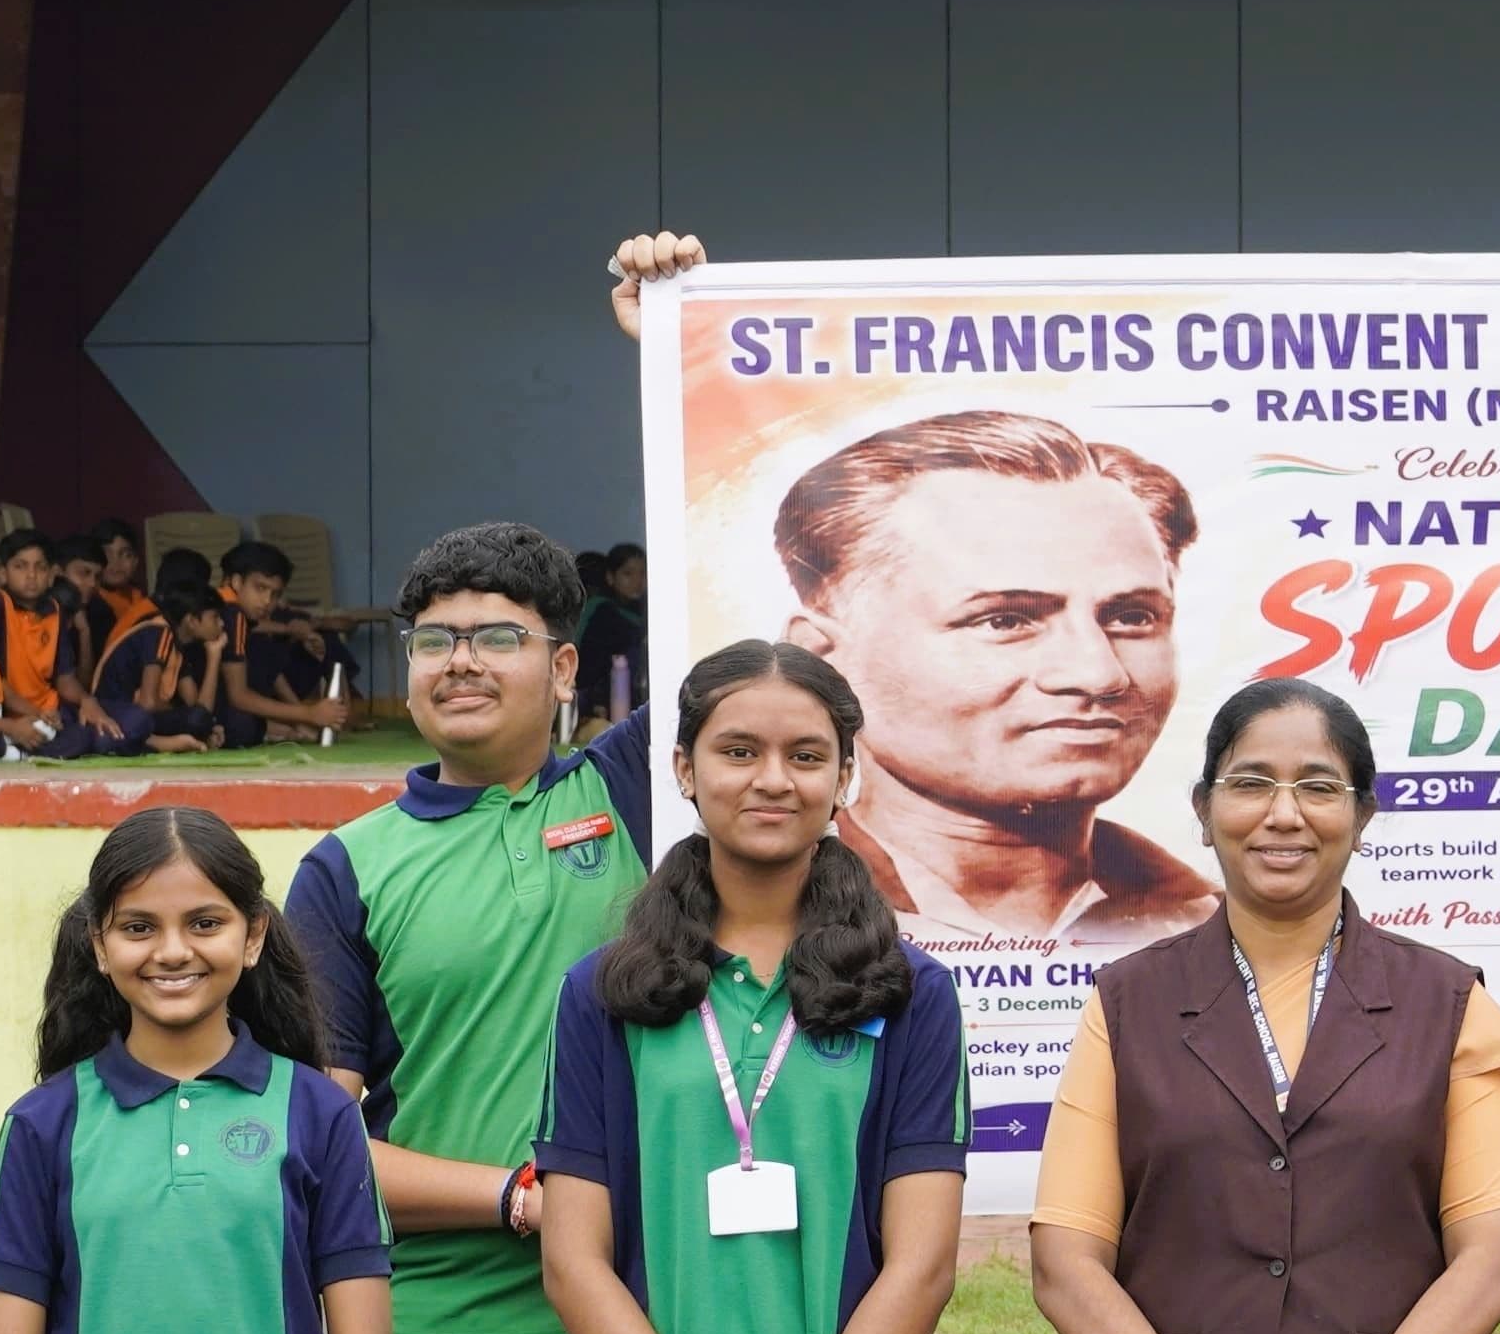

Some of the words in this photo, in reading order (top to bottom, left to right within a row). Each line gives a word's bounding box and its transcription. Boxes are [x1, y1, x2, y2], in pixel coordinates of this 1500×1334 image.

[731, 316, 831, 375] ST.
[855, 315, 1154, 373] FRANCIS
[1177, 313, 1487, 371] CONVENT
[1257, 389, 1446, 422] RAISEN
[1394, 775, 1474, 806] 29th
[1442, 839, 1498, 857] build
[1381, 865, 1494, 882] teamwork
[1370, 902, 1434, 927] with
[1252, 1011, 1274, 1053] SCHOOL,
[1266, 1051, 1287, 1084] RAISEN
